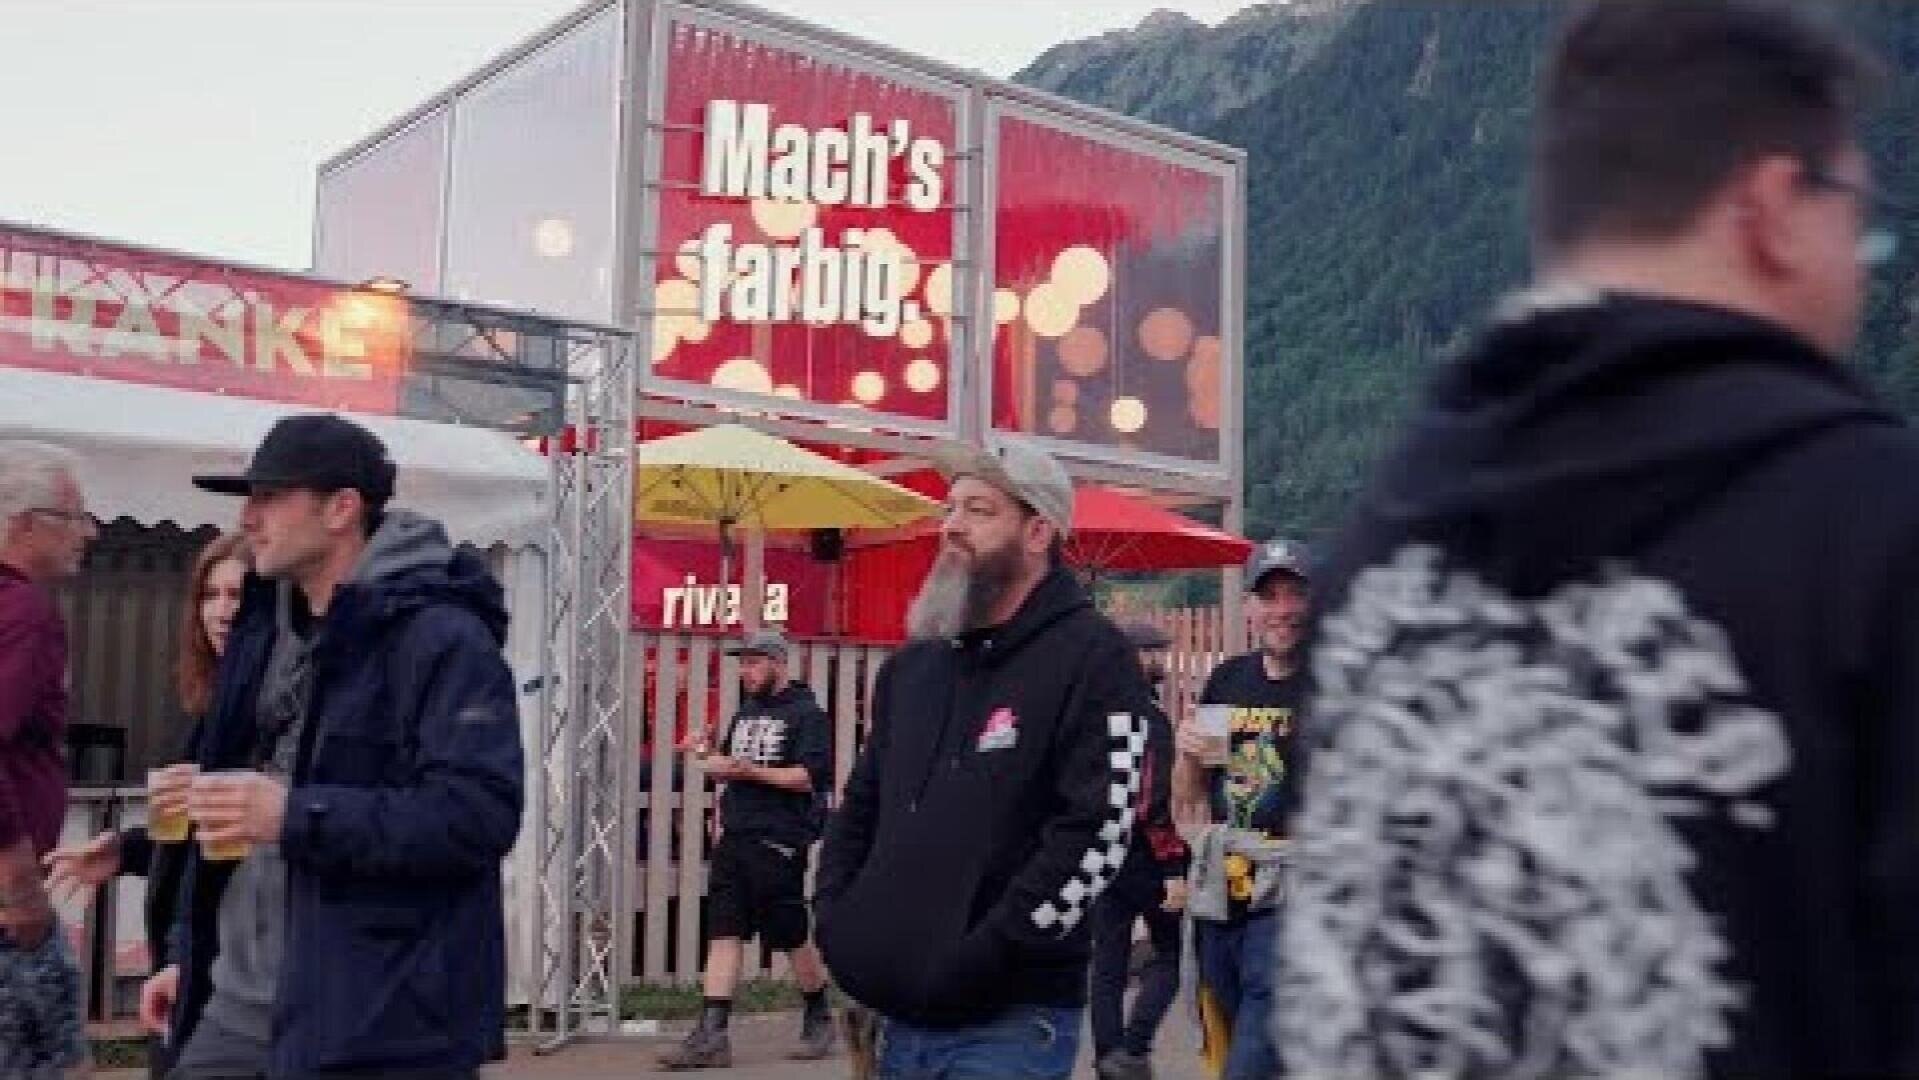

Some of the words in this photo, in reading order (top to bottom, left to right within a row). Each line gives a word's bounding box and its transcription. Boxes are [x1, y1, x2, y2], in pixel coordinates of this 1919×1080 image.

[704, 99, 944, 212] Mach's
[700, 223, 920, 337] farbig.
[663, 573, 789, 629] rivea
